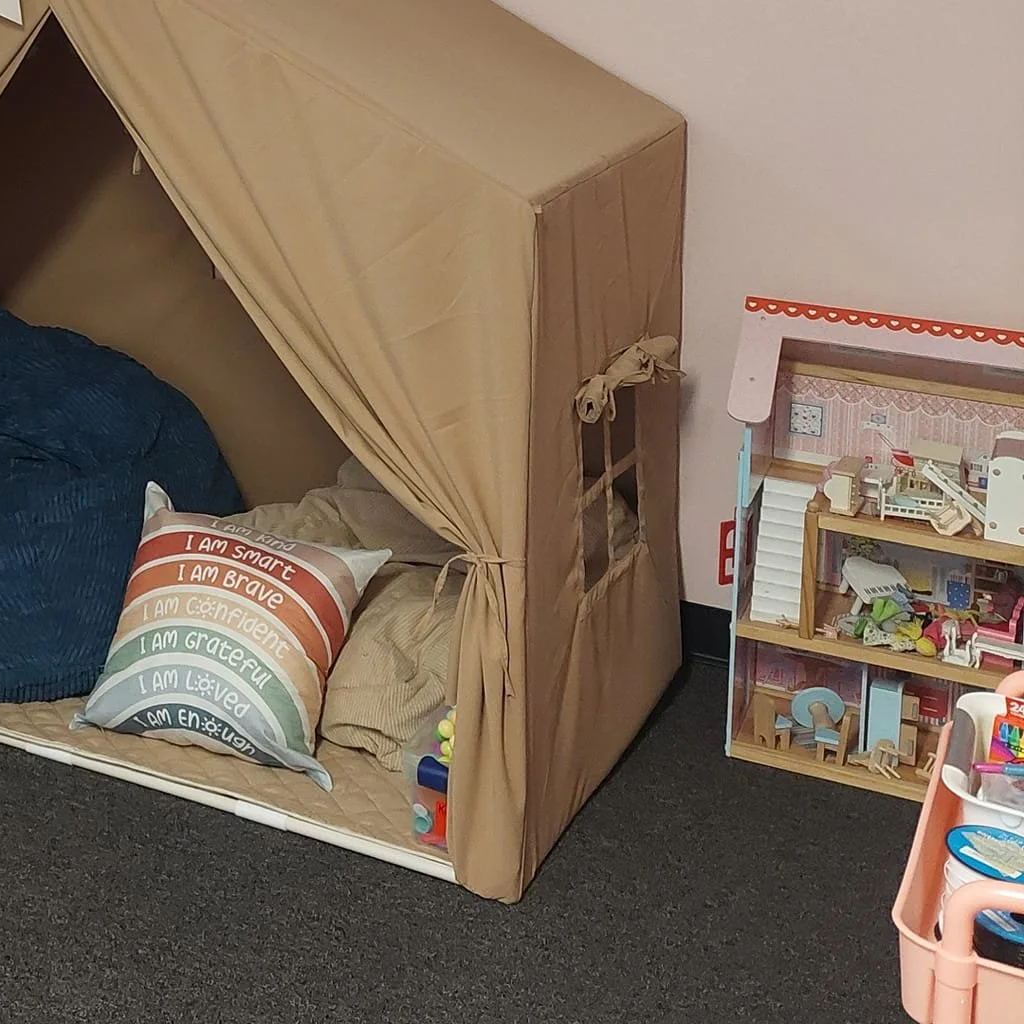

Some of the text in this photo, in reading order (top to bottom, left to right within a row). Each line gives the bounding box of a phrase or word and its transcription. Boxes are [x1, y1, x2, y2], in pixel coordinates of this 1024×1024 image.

[185, 535, 194, 550] I
[199, 537, 228, 554] AM
[211, 520, 218, 528] I
[225, 524, 252, 536] AM
[177, 564, 283, 609] I AM Brave
[143, 597, 290, 659] I AM Confident
[140, 629, 272, 690] I AM Grateful
[138, 669, 250, 718] I AM Loved
[1009, 702, 1024, 716] 24
[133, 708, 256, 755] I AM Enough
